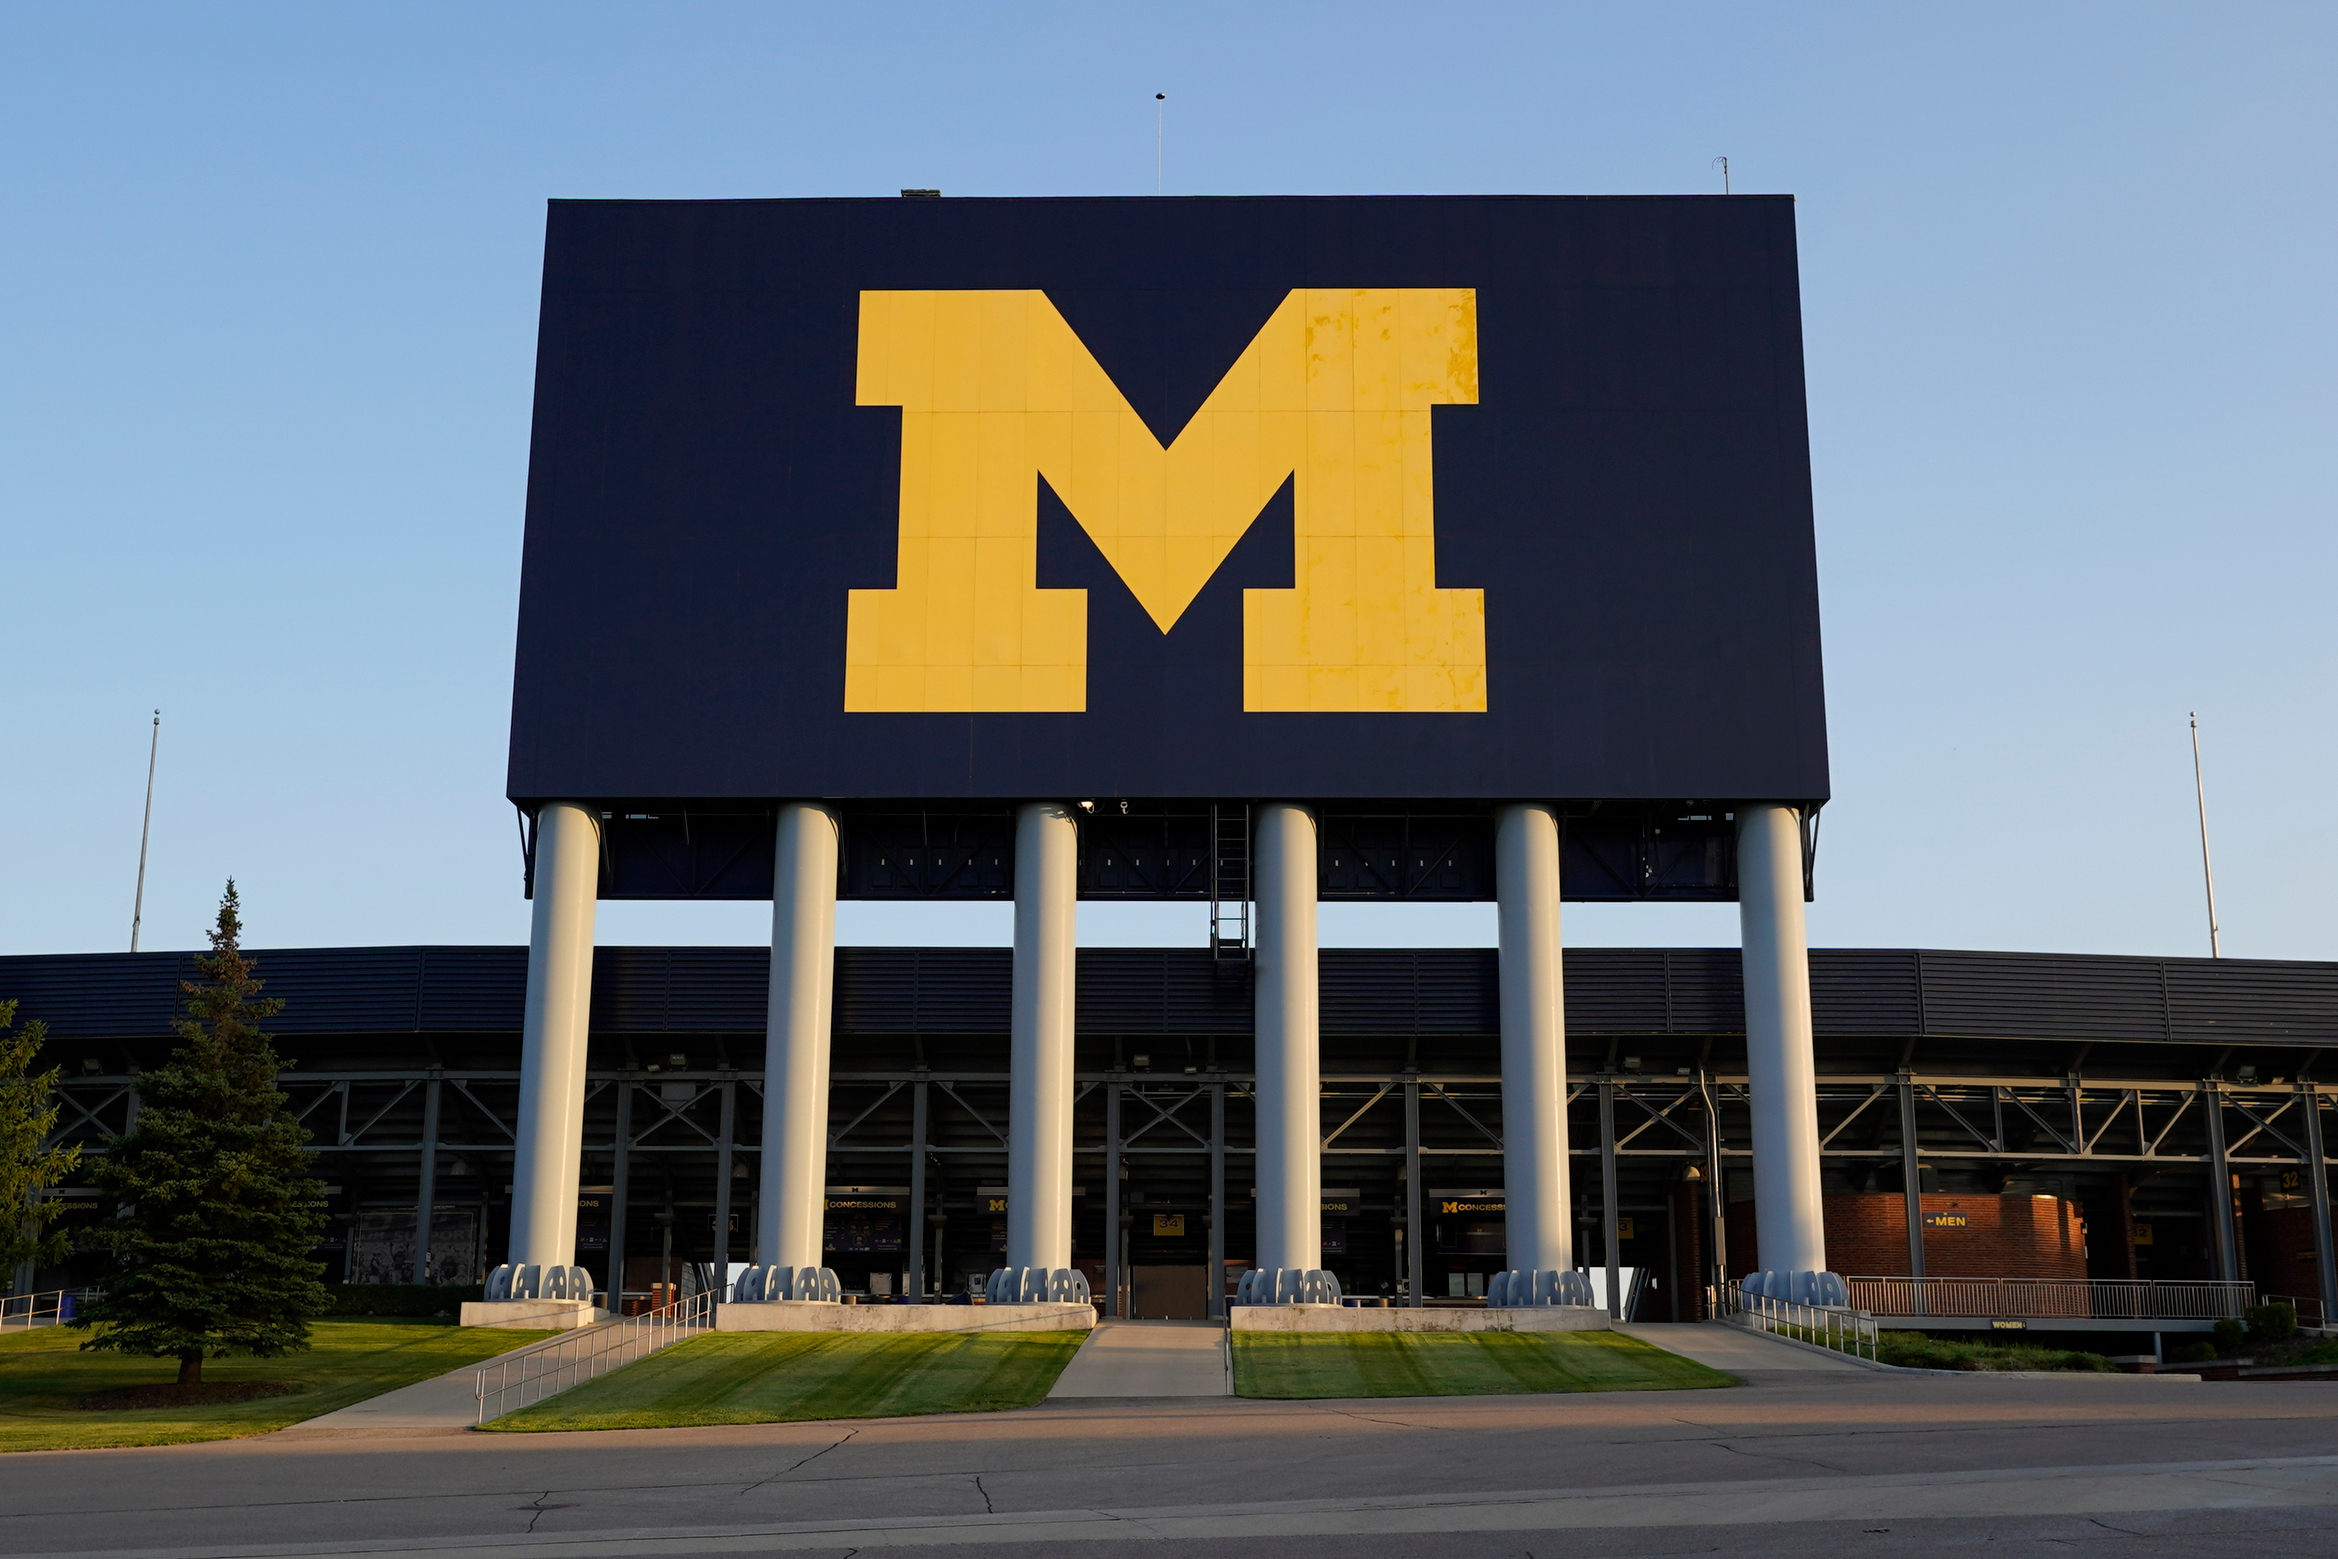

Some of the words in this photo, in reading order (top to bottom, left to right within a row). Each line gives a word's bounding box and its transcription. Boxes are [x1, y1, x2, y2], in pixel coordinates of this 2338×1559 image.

[844, 288, 1488, 713] M
[2282, 1170, 2299, 1189] 32
[829, 1201, 897, 1209] CONCESSIONS
[1442, 1201, 1458, 1214] M
[1458, 1203, 1506, 1212] CONCESSI
[1159, 1219, 1178, 1229] 34
[1618, 1222, 1628, 1232] 3
[1935, 1216, 1966, 1227] MEN
[393, 1230, 476, 1242] SUPORT
[1992, 1321, 2023, 1329] WOMEN
